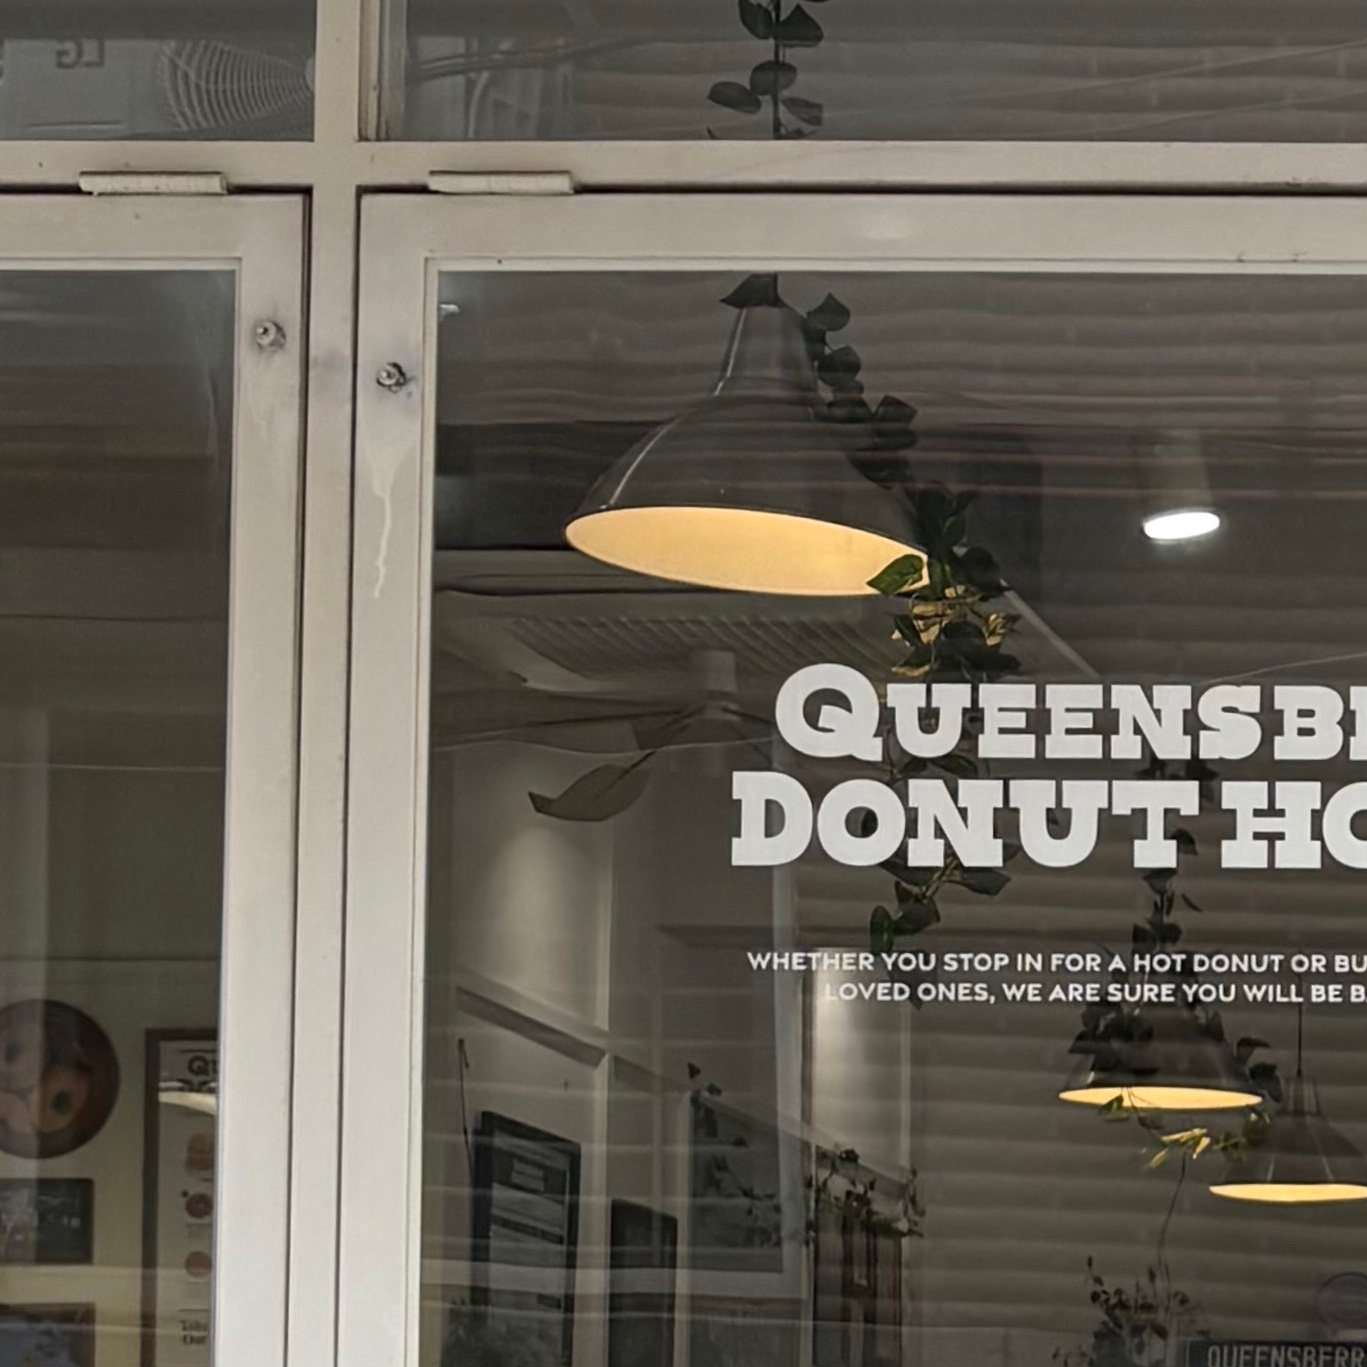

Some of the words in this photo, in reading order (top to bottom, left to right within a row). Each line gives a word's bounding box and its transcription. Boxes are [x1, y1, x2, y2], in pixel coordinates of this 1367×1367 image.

[731, 770, 1199, 868] DONUT
[747, 952, 874, 971] WHETHER
[881, 952, 936, 971] YOU
[943, 953, 1010, 972] STOP
[1017, 953, 1043, 972] IN
[1051, 953, 1101, 972] FOR
[1108, 954, 1126, 972] A
[1134, 954, 1186, 972] HOT
[1193, 954, 1285, 973] DONUT
[1291, 954, 1327, 973] OR
[825, 982, 910, 1001] LOVED
[917, 982, 995, 1004] ONES,
[1002, 983, 1042, 1002] WE
[1048, 983, 1101, 1002] ARE
[1107, 983, 1176, 1002] SURE
[1182, 983, 1236, 1002] YOU
[1243, 984, 1304, 1003] WILL
[1311, 984, 1343, 1003] BE
